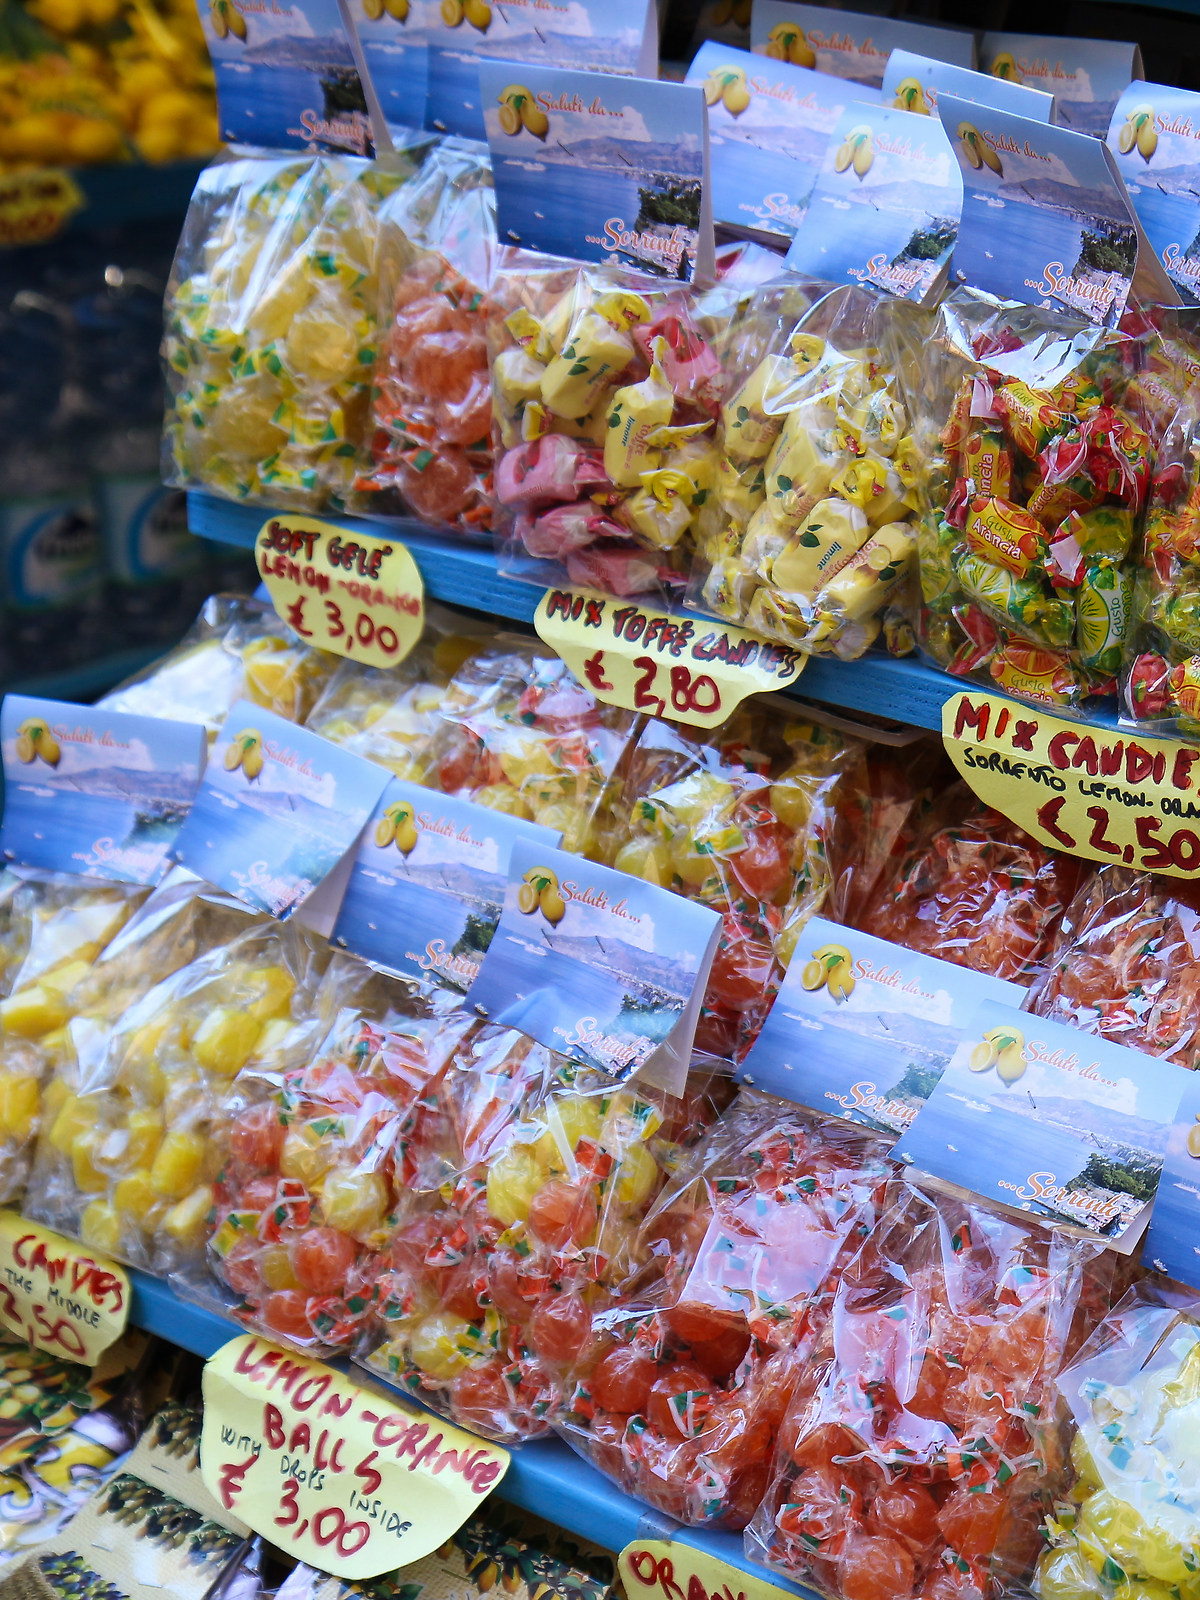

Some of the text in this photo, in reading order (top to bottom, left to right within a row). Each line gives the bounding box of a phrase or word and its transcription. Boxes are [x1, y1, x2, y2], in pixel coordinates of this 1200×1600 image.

[260, 521, 321, 561] SOFT
[972, 518, 1023, 561] Arancia
[985, 515, 1014, 542] Gusto
[261, 552, 331, 595] LEMON
[816, 541, 843, 571] limone
[324, 600, 400, 655] 3,00
[546, 590, 605, 628] MIX
[1110, 597, 1124, 638] Gusto
[633, 656, 722, 717] 2,80
[1010, 673, 1046, 691] Gusto
[954, 696, 1038, 752] MIX
[963, 747, 1067, 792] SORRENTO
[221, 1424, 413, 1538] WITH DROPS INSIDE
[274, 1480, 371, 1558] 3,00
